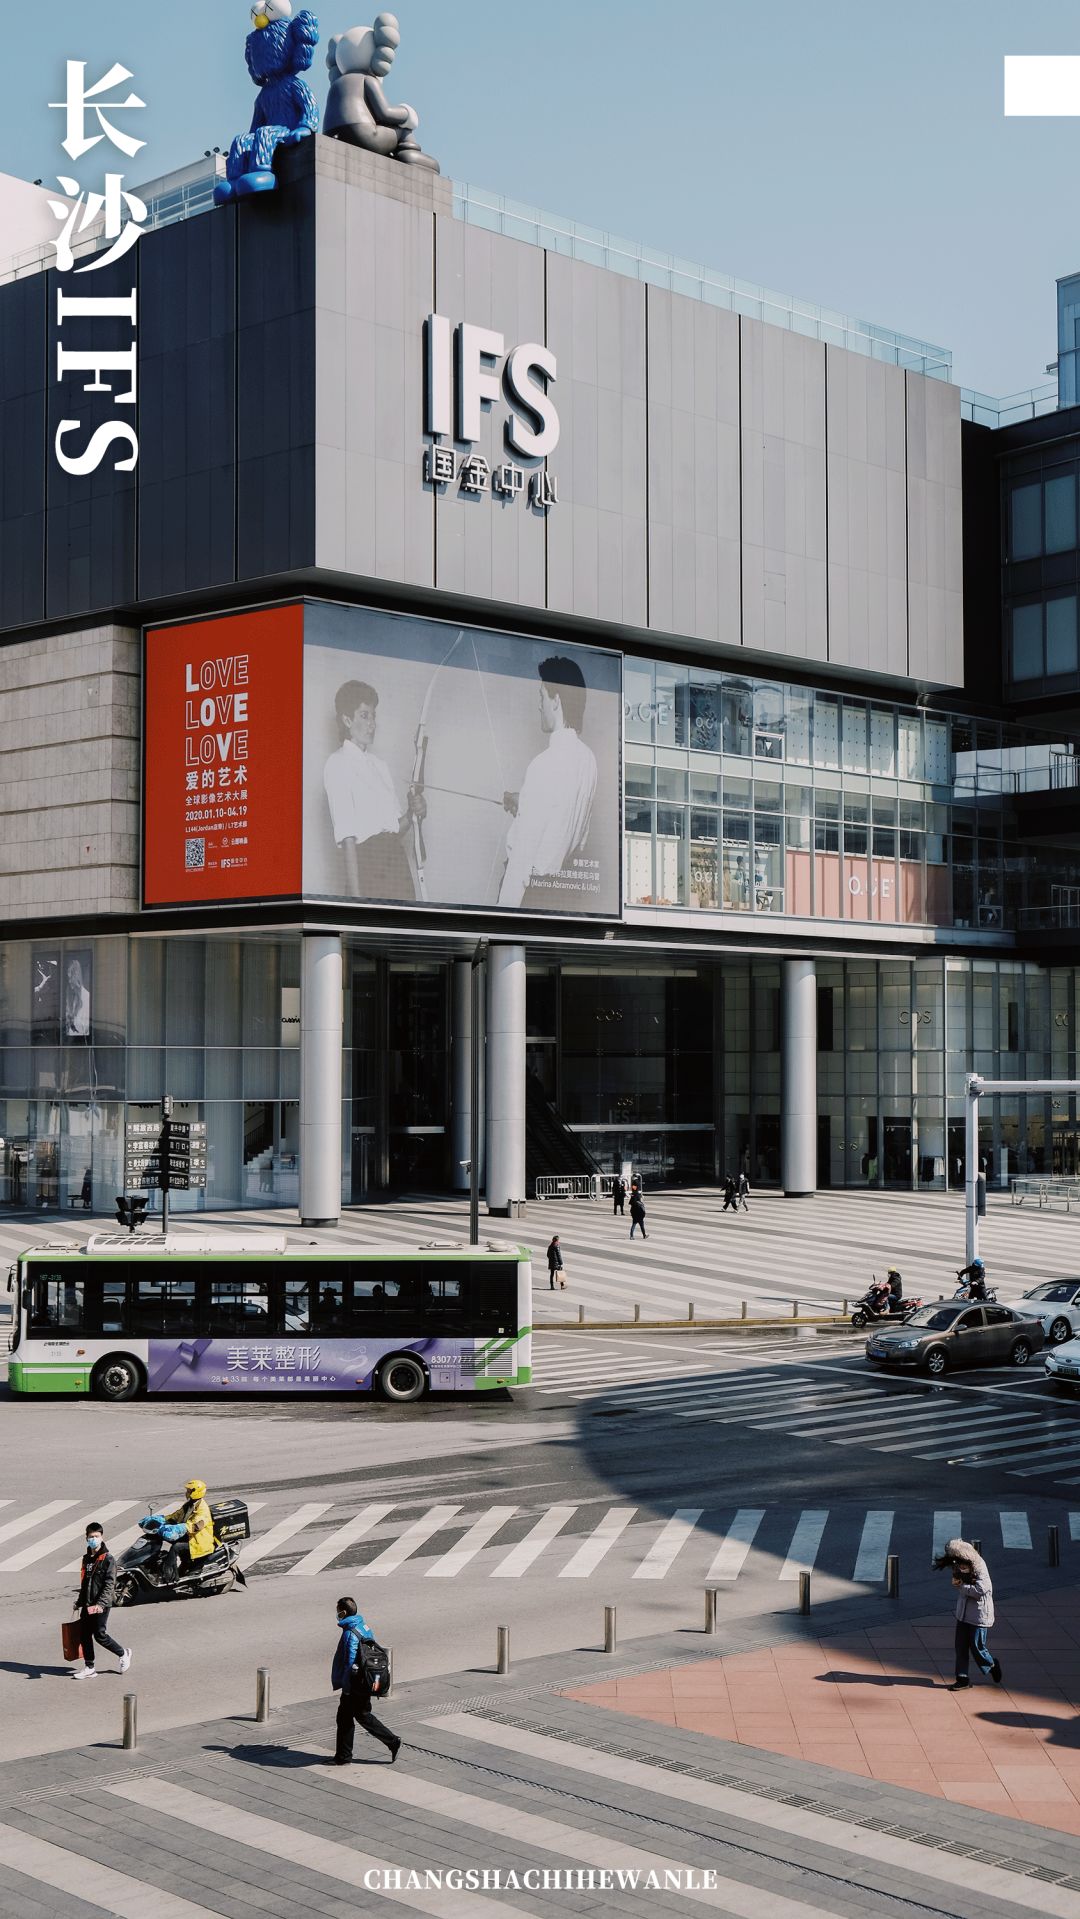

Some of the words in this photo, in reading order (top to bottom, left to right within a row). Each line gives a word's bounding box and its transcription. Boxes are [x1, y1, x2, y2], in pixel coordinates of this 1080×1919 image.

[428, 313, 560, 457] IFS
[428, 444, 559, 507] 国金中心
[185, 654, 249, 693] LOVE
[185, 692, 249, 730] LOVE
[185, 729, 249, 767] LOVE
[185, 765, 248, 790] 爱的艺术
[185, 789, 248, 806] 全球影像艺术大展
[185, 805, 248, 821] 2020.01.10-04.19
[226, 1345, 322, 1372] 美莱整形
